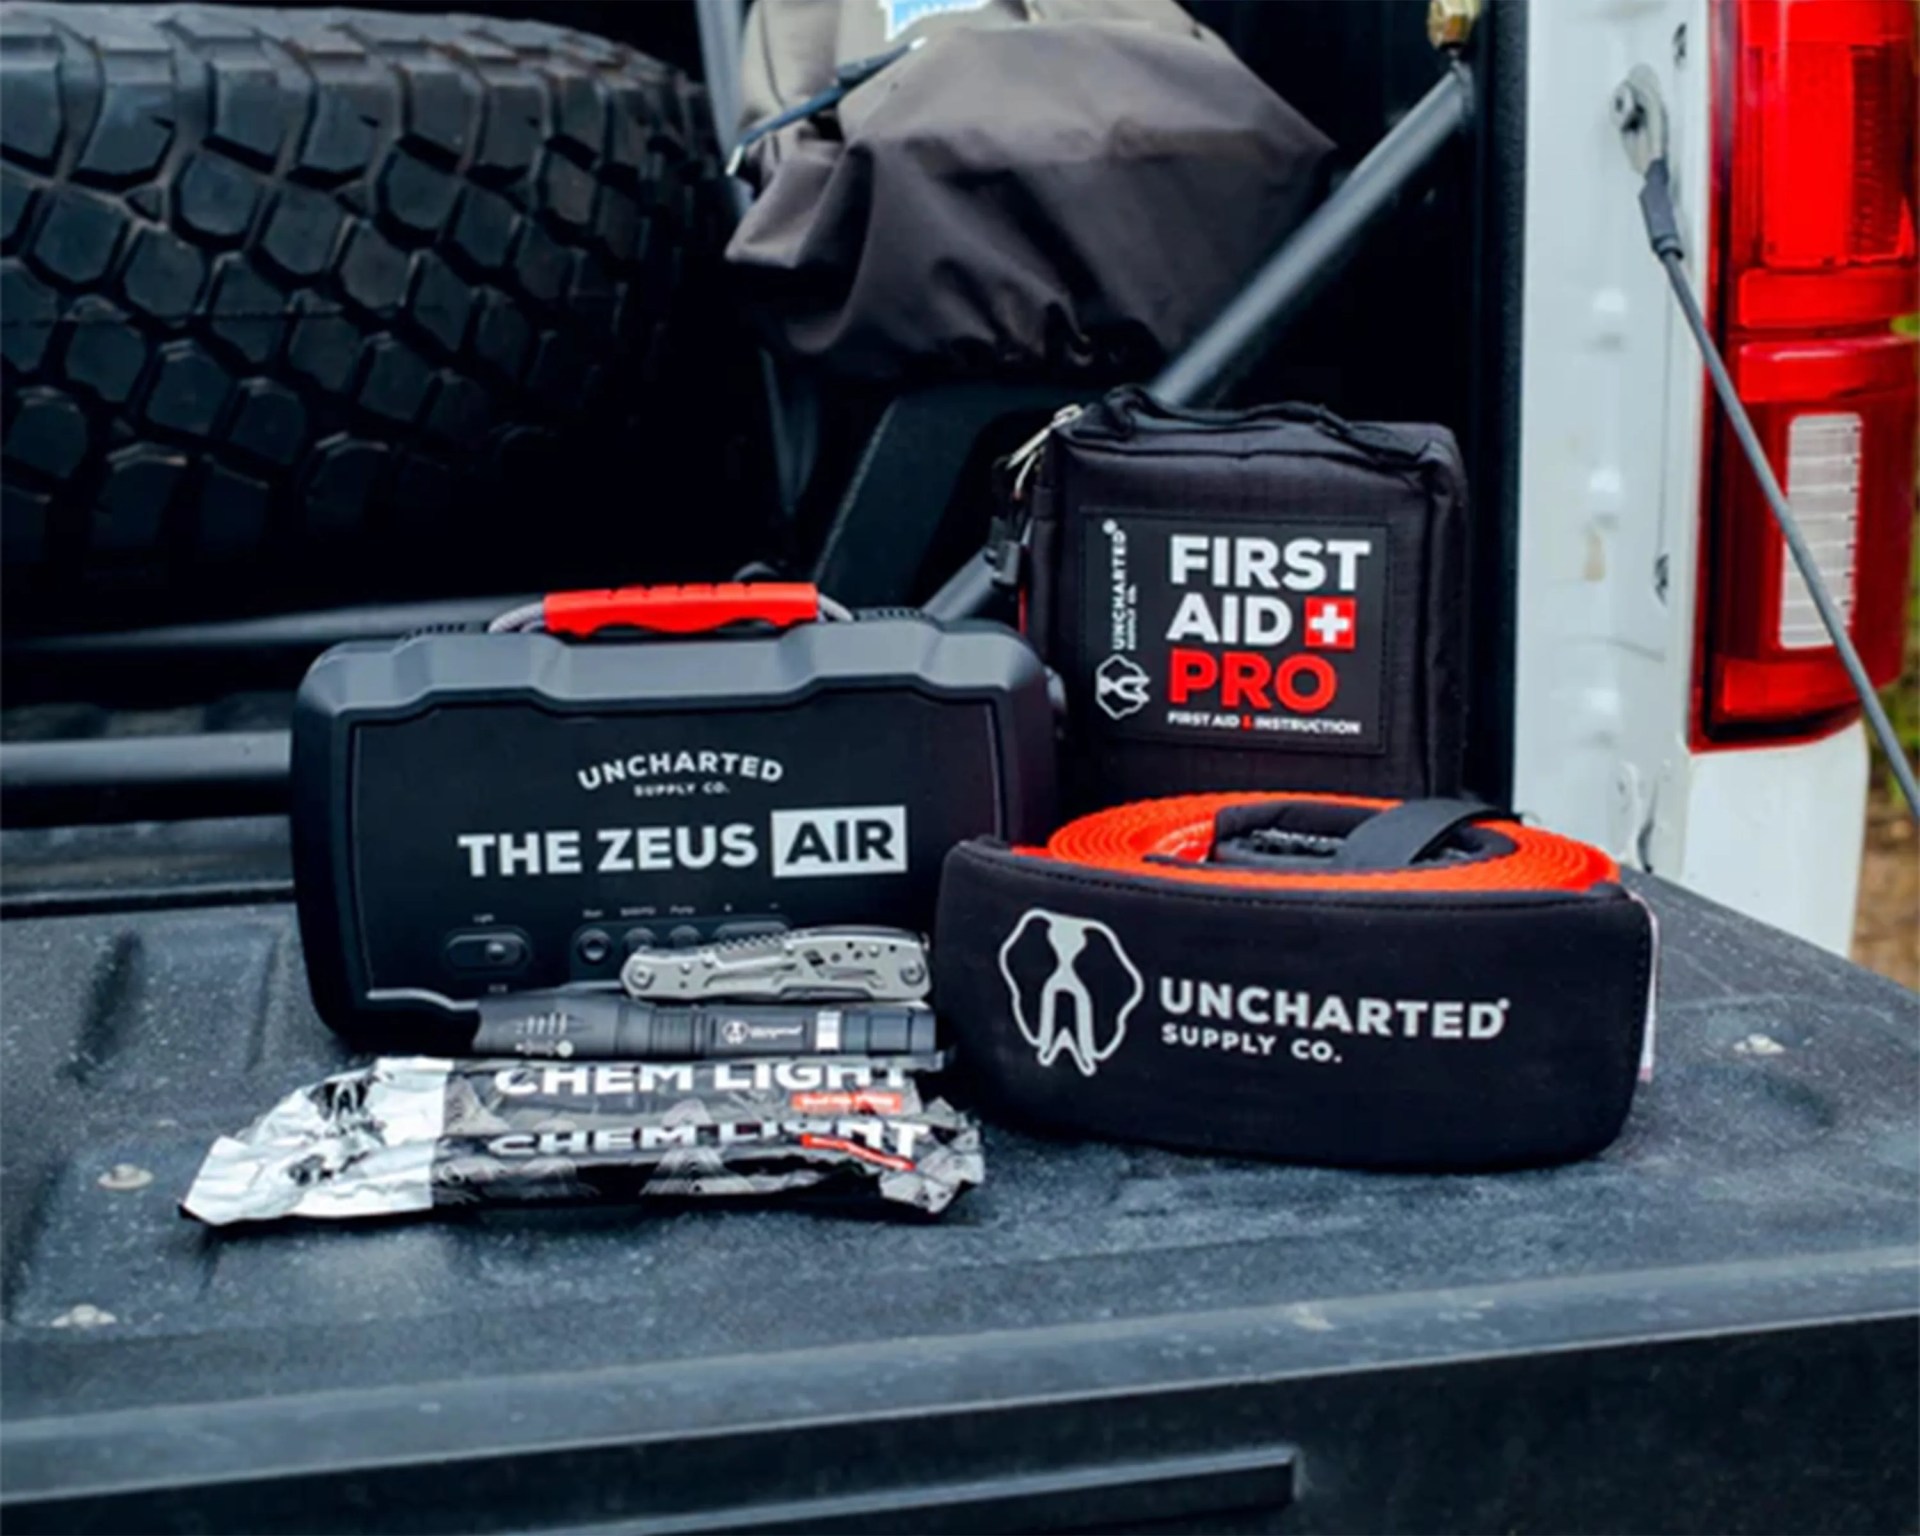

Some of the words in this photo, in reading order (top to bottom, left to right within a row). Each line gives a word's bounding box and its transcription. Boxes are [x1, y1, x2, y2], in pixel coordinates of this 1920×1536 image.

[1170, 534, 1371, 591] FIRST
[1166, 593, 1293, 646] AID
[1169, 648, 1338, 713] PRO
[1167, 711, 1210, 727] FIRST
[1211, 714, 1240, 729] AID
[1254, 715, 1361, 735] INSTRUCTION
[577, 750, 784, 791] UNCHARTED
[634, 782, 696, 797] SUPPLY
[457, 832, 582, 878] THE
[597, 823, 759, 872] ZEUS
[785, 819, 896, 865] AIR
[1162, 1022, 1276, 1056] SUPPLY
[1291, 1038, 1343, 1064] CO.
[494, 1064, 694, 1096] CHEM
[714, 1064, 904, 1090] LIGHT
[488, 1124, 697, 1156] CHEM
